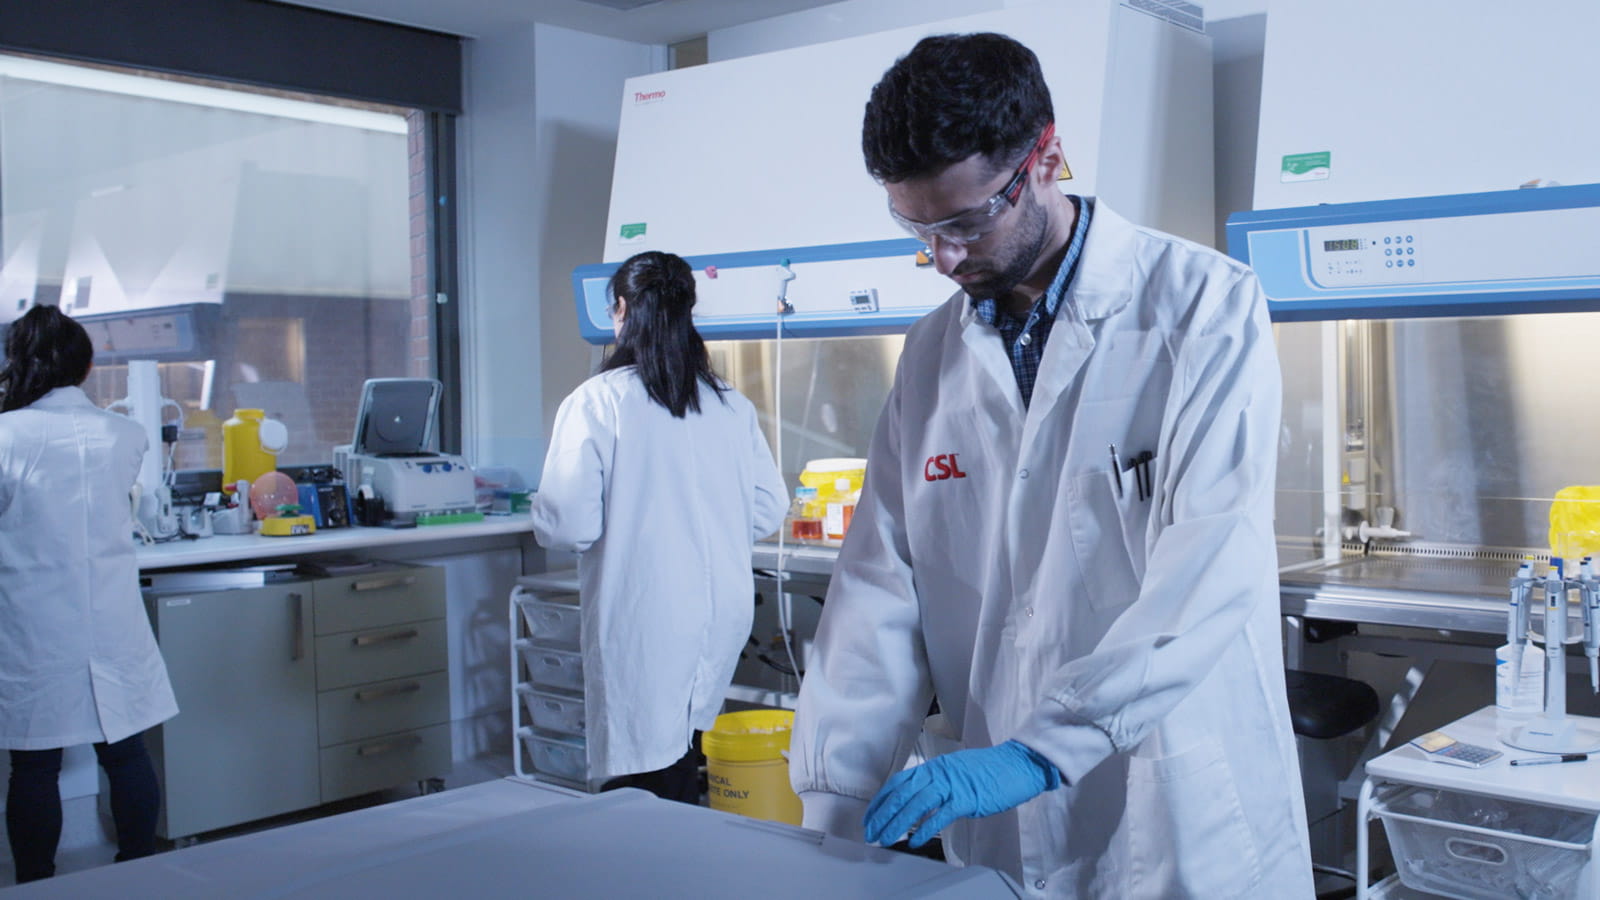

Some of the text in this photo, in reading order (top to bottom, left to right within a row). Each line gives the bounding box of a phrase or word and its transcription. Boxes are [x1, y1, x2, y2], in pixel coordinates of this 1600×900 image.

[634, 90, 666, 102] Thermo
[924, 453, 966, 481] CSL
[723, 788, 750, 800] ONLY
